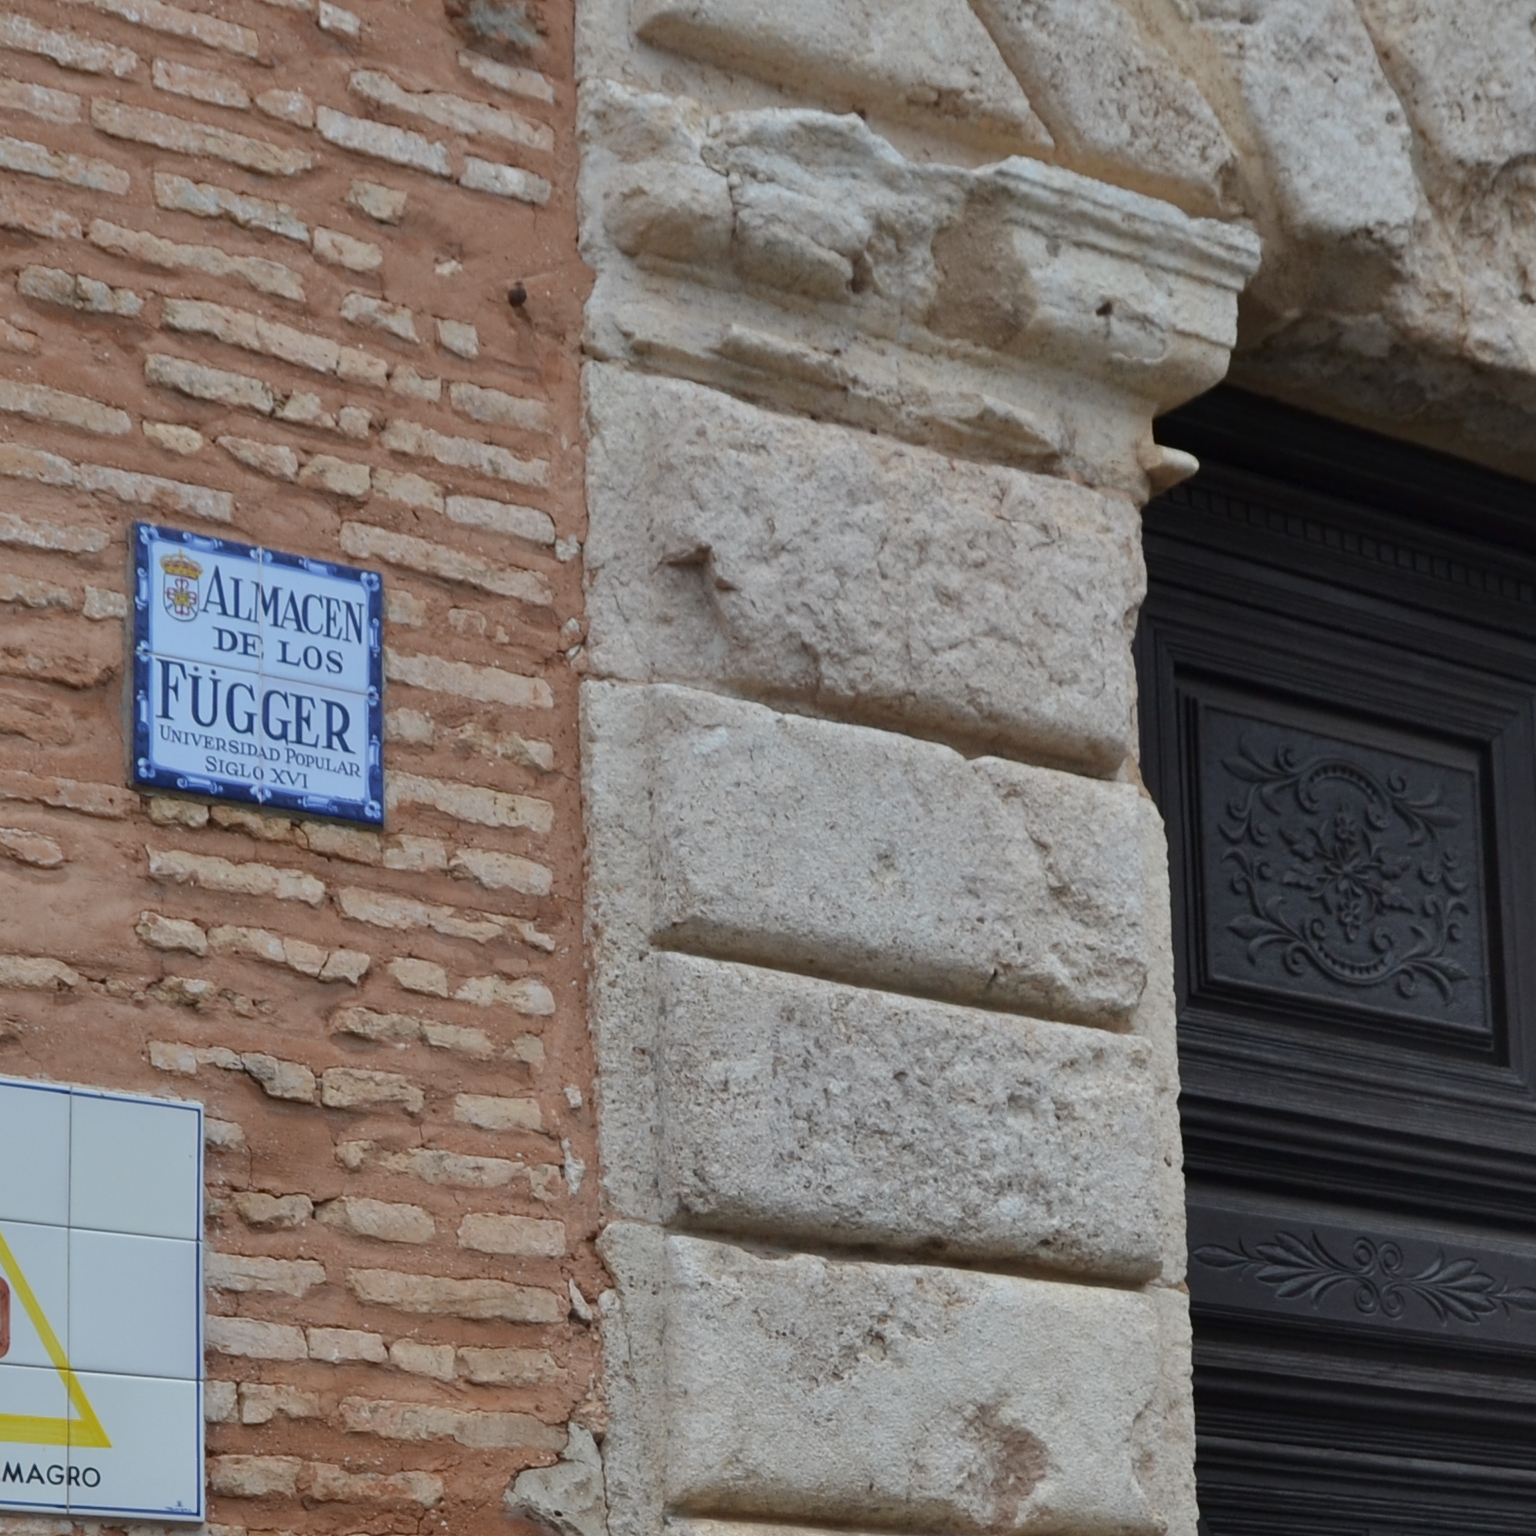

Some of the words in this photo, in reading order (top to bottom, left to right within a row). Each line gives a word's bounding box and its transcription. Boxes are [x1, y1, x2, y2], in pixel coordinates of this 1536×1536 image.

[199, 565, 365, 645] ALMACEN
[212, 626, 264, 660] DE
[277, 640, 344, 675] LOS
[155, 657, 356, 755] FÜGGER
[159, 724, 281, 762] UNIVERSIDAD
[285, 747, 362, 778] POPULAR
[205, 755, 264, 780] SIGLO
[270, 767, 309, 789] XVI
